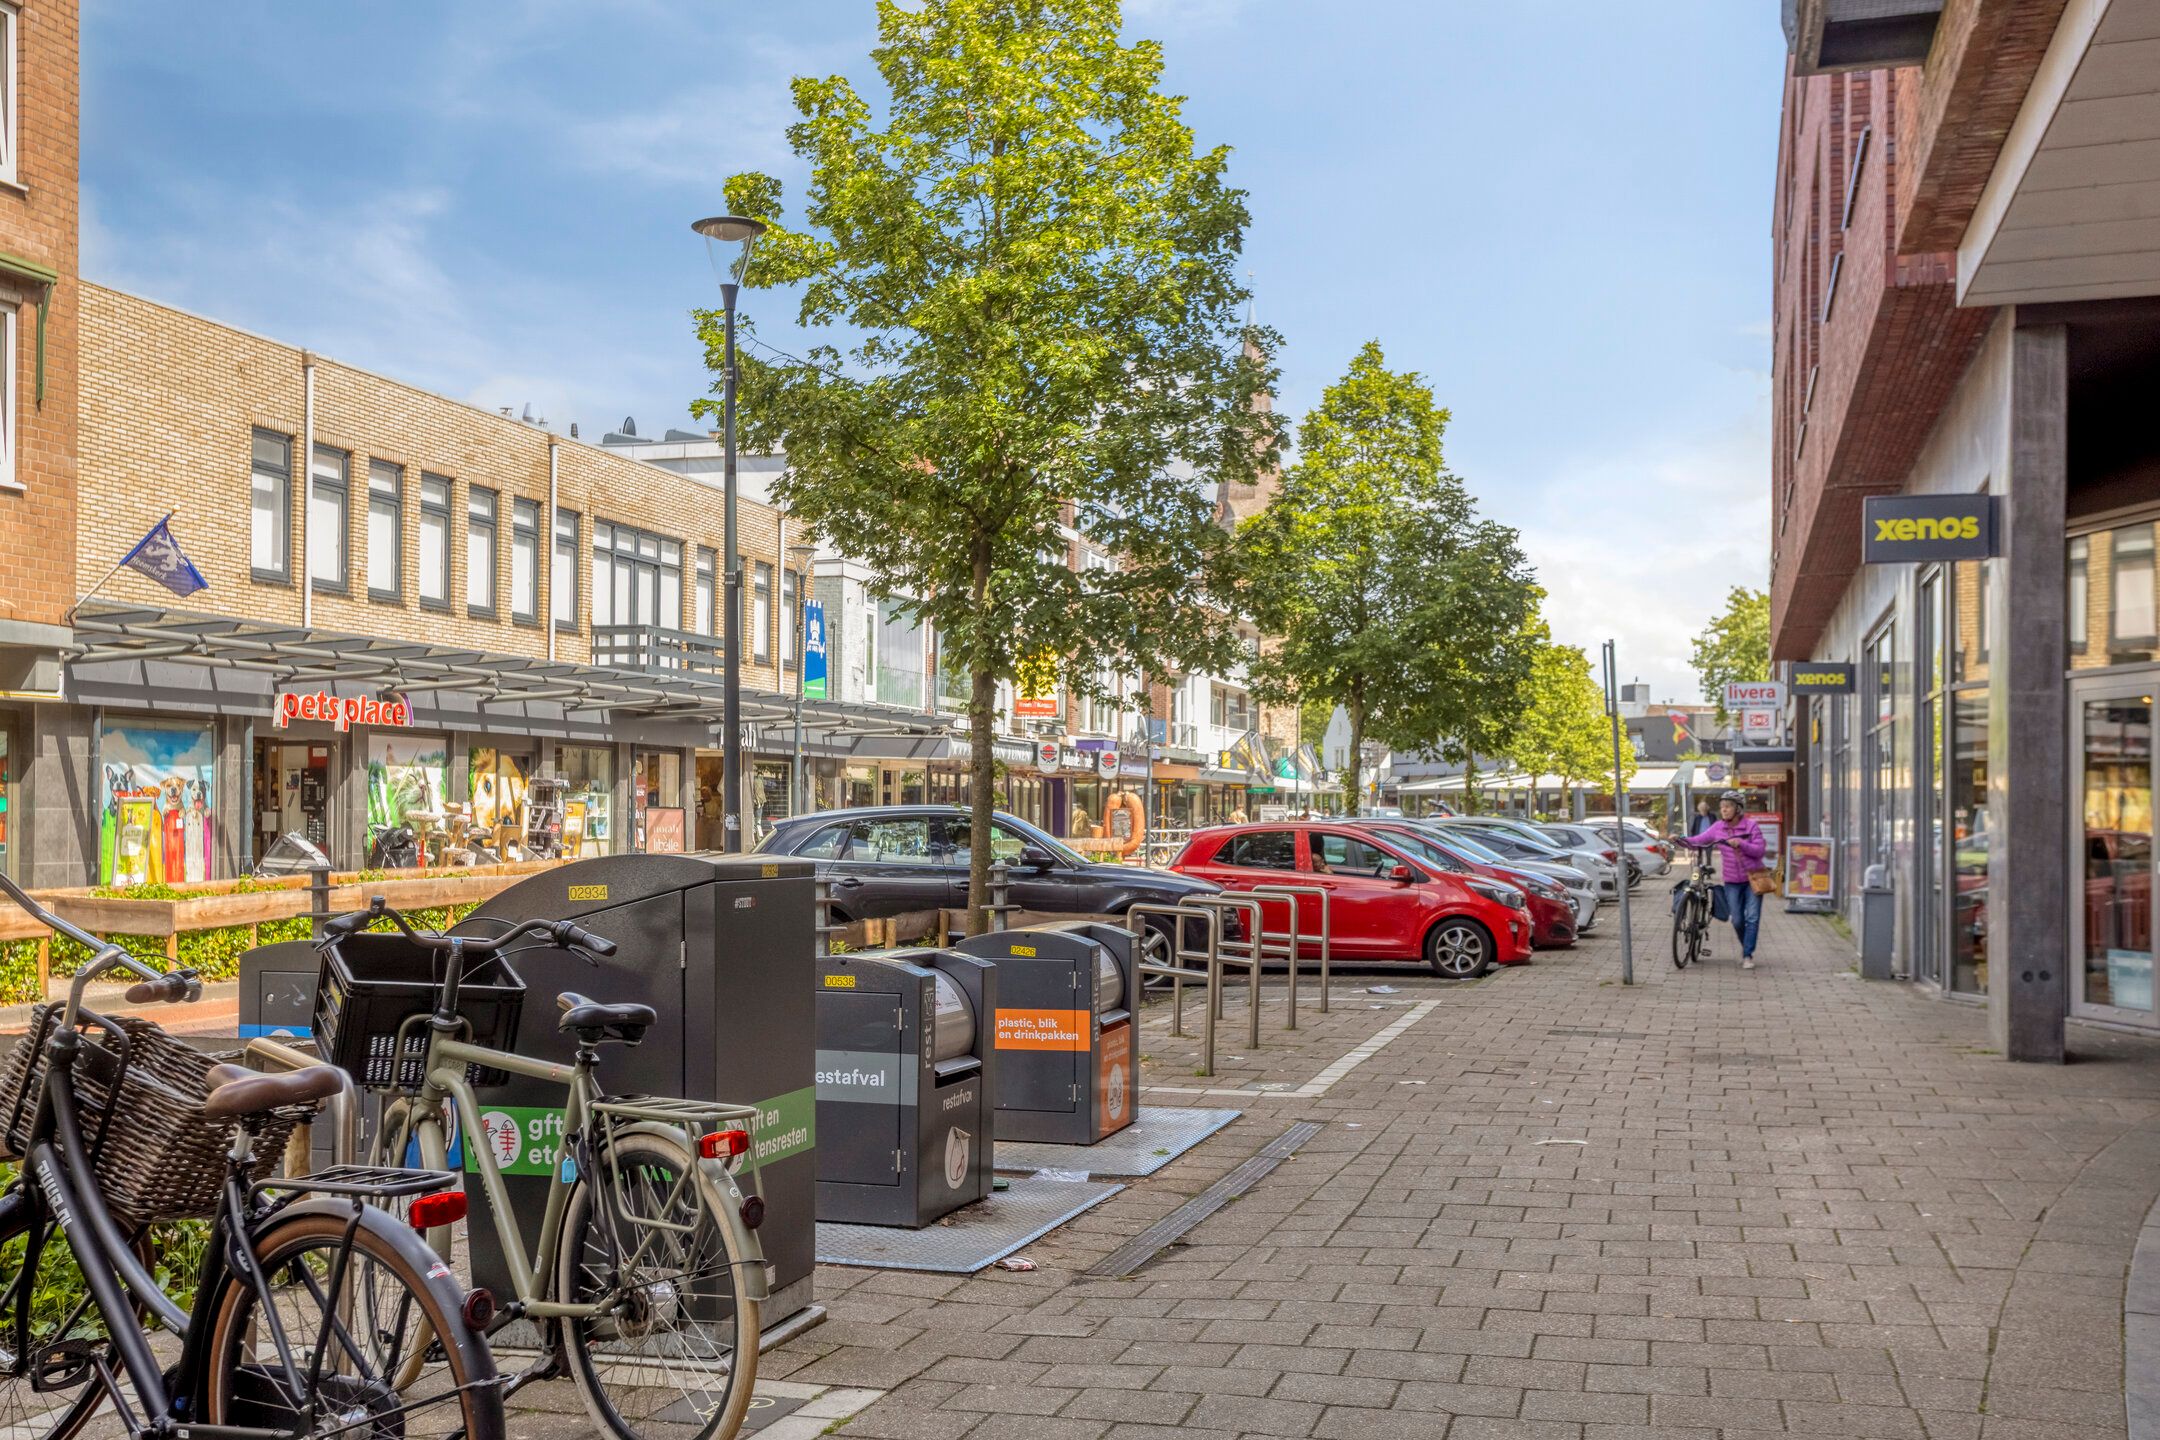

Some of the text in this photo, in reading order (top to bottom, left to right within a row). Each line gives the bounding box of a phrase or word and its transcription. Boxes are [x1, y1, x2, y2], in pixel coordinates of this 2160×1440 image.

[1874, 516, 1980, 541] xenos
[131, 556, 167, 580] Heemskerk
[1795, 672, 1846, 685] xenos
[1729, 684, 1776, 699] livera
[281, 690, 406, 732] pets place
[569, 886, 607, 900] 02934
[1011, 946, 1035, 956] 02426
[825, 976, 855, 987] 00538
[999, 1018, 1058, 1029] plastic, blik
[999, 1030, 1079, 1041] en drinkpakken
[815, 1068, 885, 1087] estafval
[942, 1088, 973, 1111] restafva
[528, 1113, 563, 1141] gft
[766, 1109, 779, 1127] en
[750, 1128, 808, 1160] tensresten
